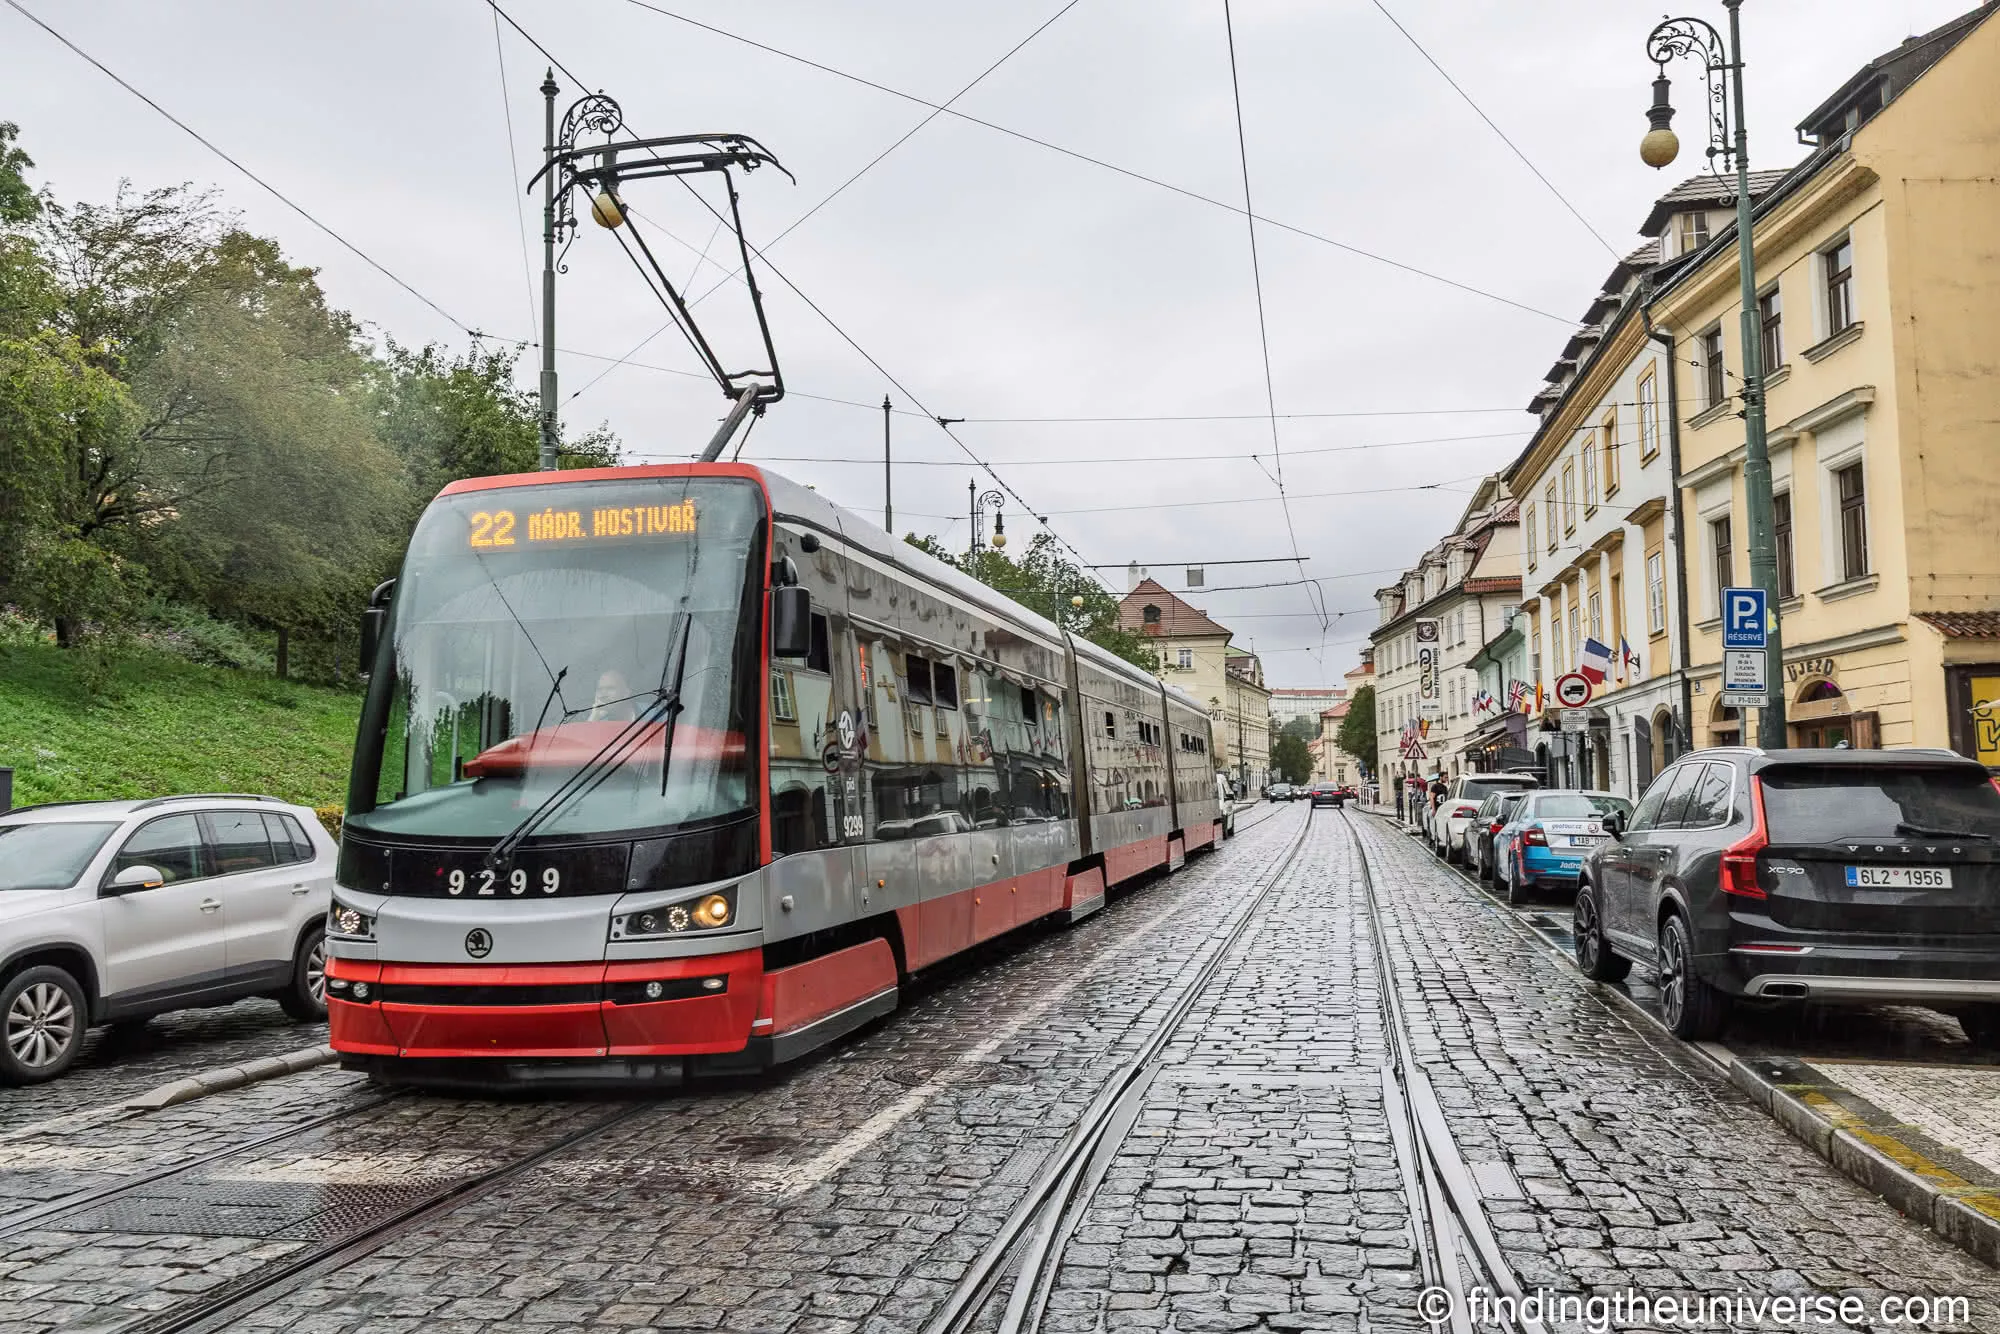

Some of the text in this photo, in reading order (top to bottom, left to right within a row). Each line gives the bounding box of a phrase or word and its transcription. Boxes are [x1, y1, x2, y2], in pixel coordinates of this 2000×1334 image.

[470, 497, 697, 547] 22 NÁDR. HOSTIVAŘ
[1732, 595, 1758, 630] P
[1727, 632, 1763, 641] RÉSERVÉ
[843, 815, 864, 837] 9299
[1847, 845, 1959, 854] VOLVO
[448, 867, 560, 895] 9299
[1860, 869, 1944, 886] 6L2 1956
